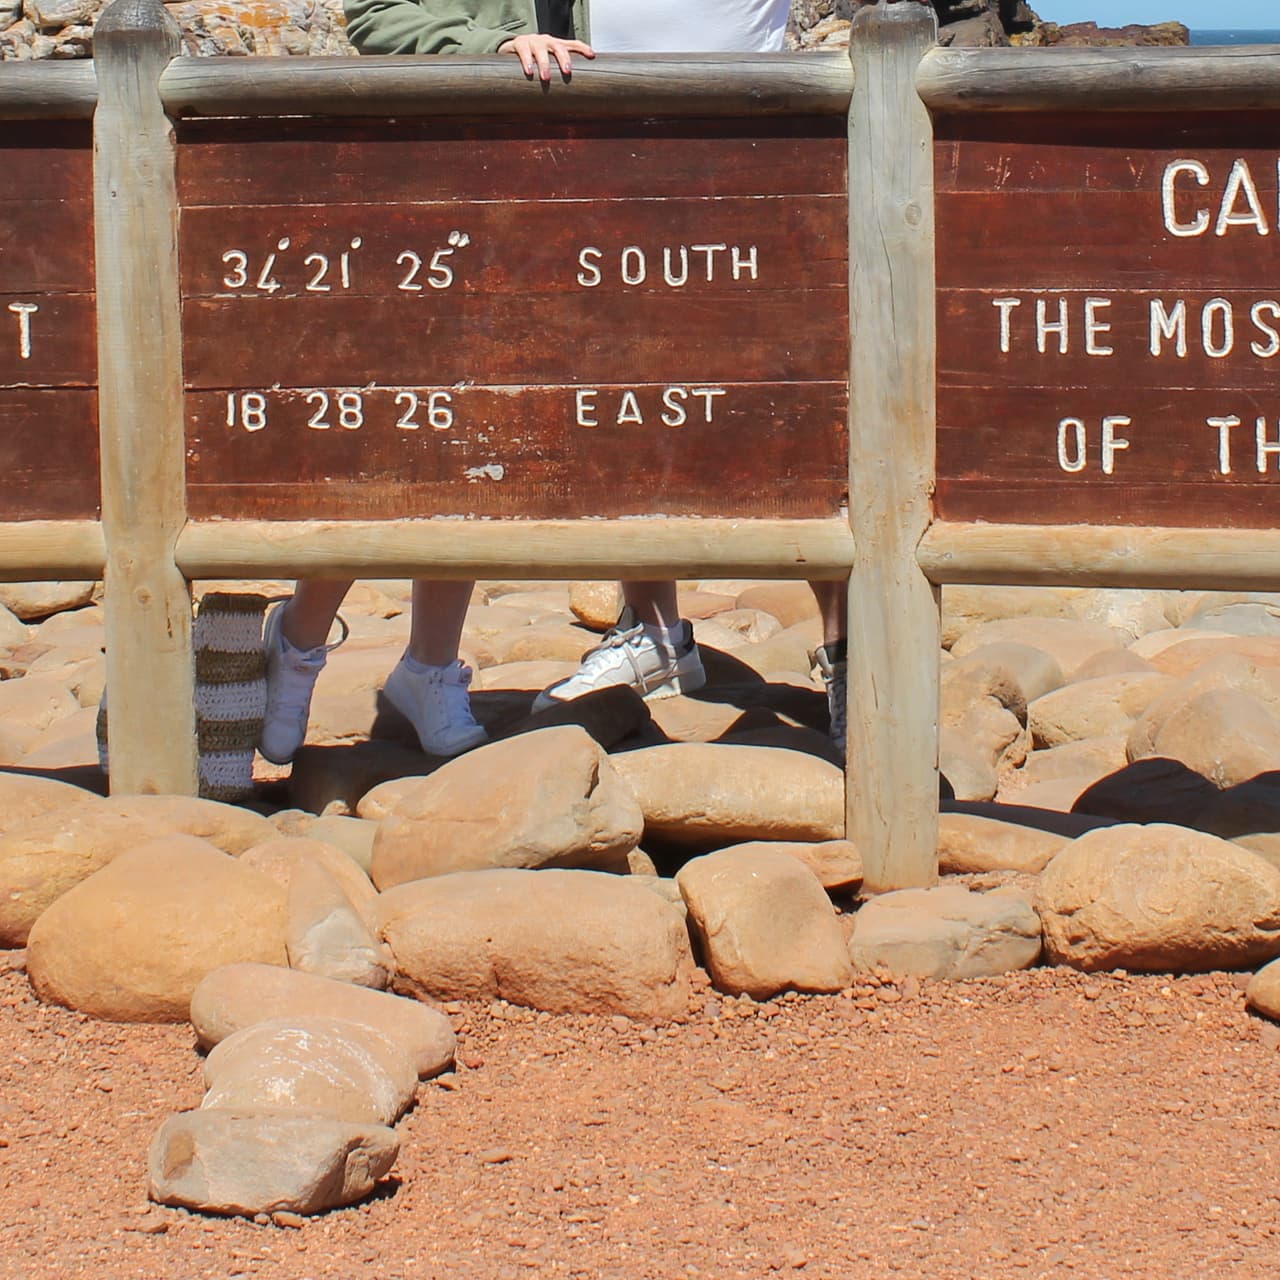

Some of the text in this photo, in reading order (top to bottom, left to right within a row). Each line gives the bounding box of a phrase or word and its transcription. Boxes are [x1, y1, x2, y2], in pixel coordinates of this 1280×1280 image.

[575, 241, 759, 288] SOUTH
[990, 295, 1115, 357] THE
[574, 386, 727, 428] EAST
[1056, 414, 1133, 476] OF
